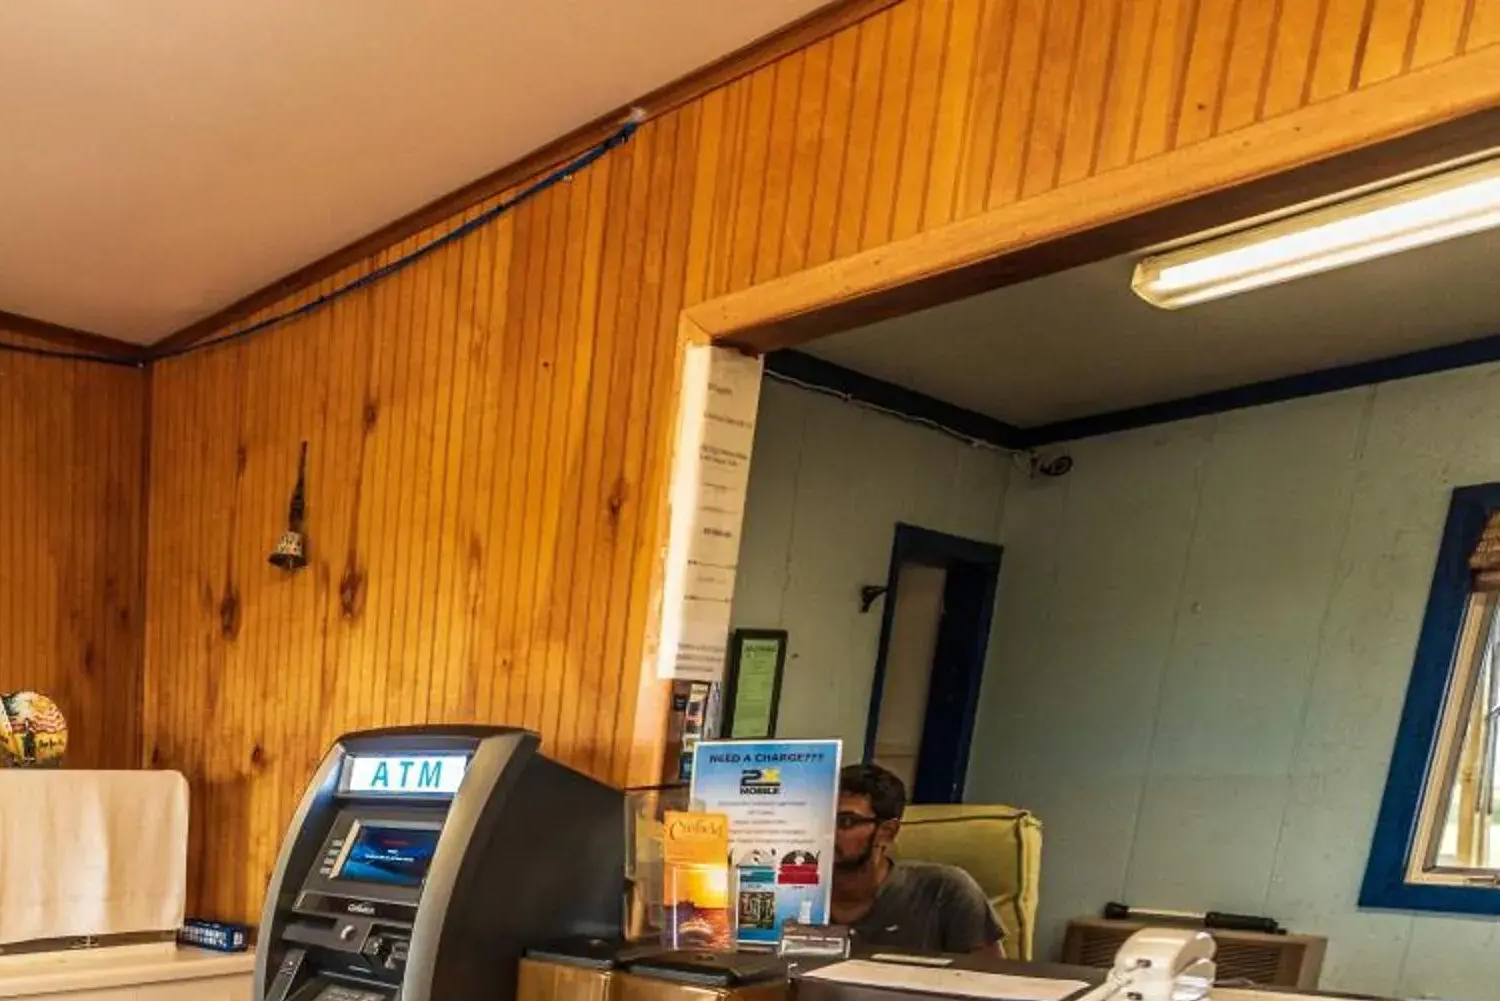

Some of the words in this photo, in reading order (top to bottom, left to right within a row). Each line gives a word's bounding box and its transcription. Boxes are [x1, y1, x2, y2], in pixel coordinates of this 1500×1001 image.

[709, 753, 740, 763] NEED
[742, 753, 752, 763] A
[370, 760, 442, 788] ATM
